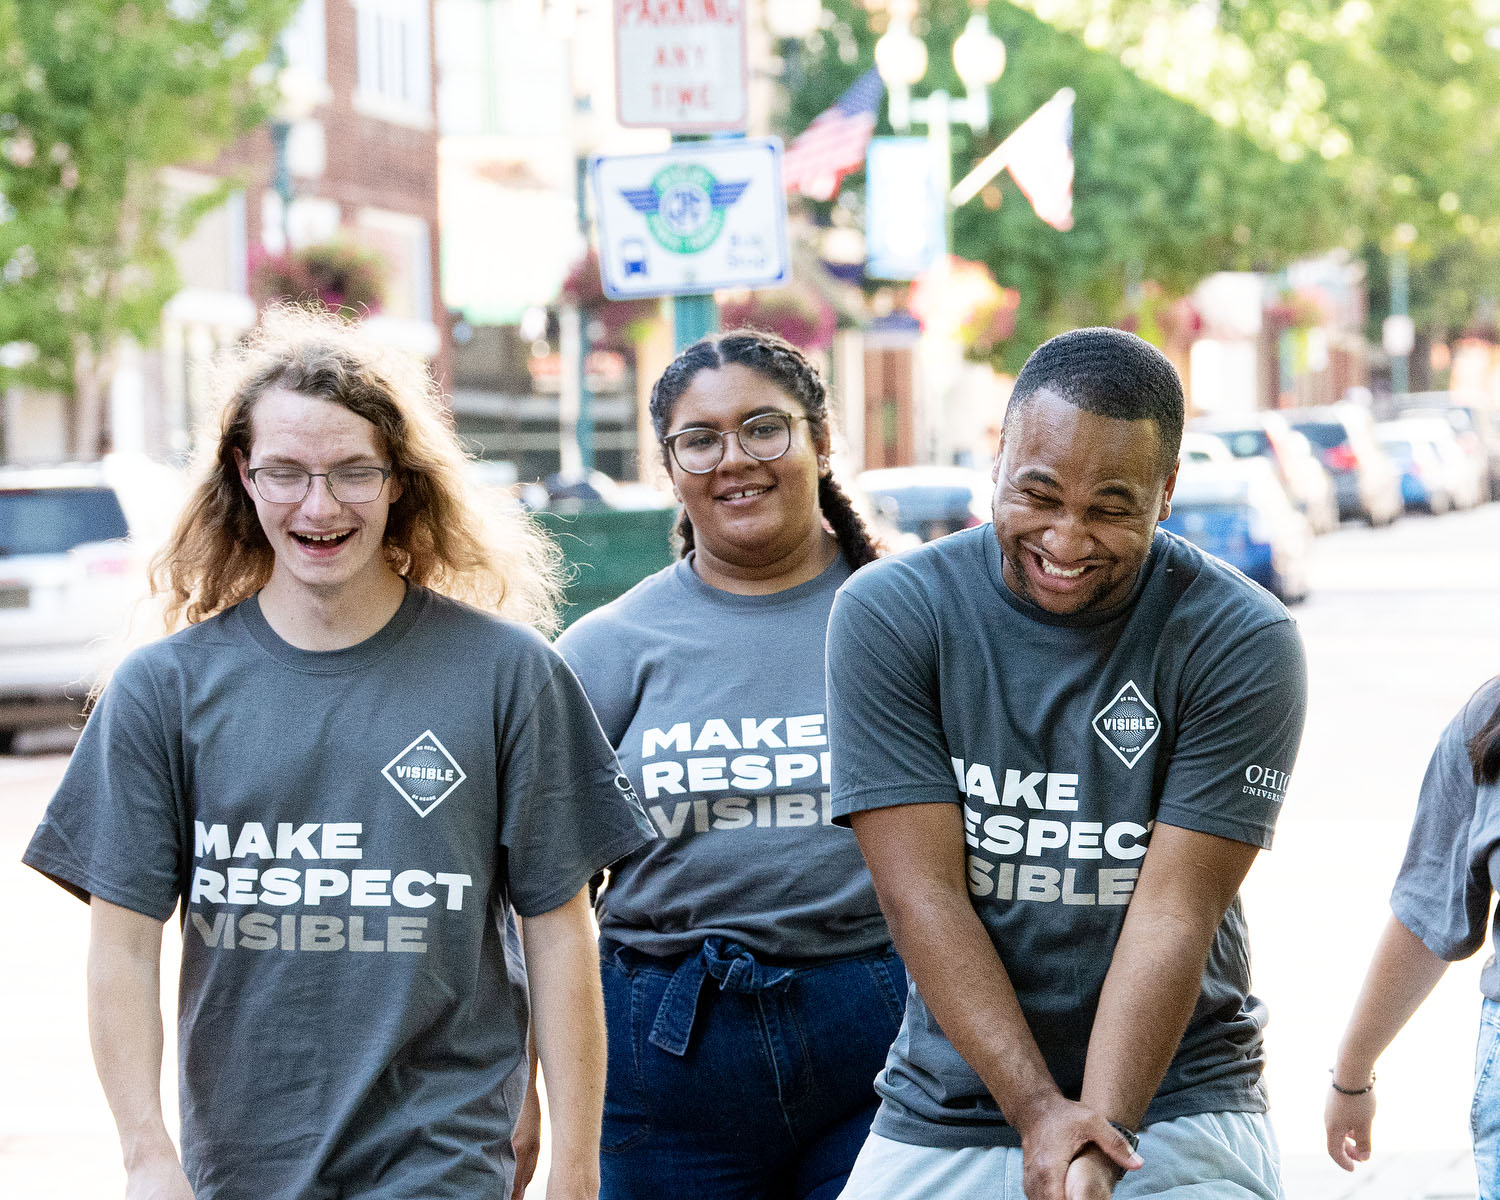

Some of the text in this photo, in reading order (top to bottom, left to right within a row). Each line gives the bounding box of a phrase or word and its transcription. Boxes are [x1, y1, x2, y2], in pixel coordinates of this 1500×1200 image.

[654, 45, 707, 68] ANY
[651, 82, 712, 110] TIME
[642, 713, 827, 758] MAKE
[1103, 717, 1155, 731] VISIBLE
[396, 765, 454, 782] VISIBLE
[642, 752, 830, 799] RESP
[1242, 785, 1285, 803] UNIVERS
[650, 792, 831, 839] VISIB
[964, 802, 1154, 860] ESPEC
[194, 820, 363, 860] MAKE
[191, 866, 473, 911] RESPECT
[967, 855, 1139, 906] SIBLE
[190, 912, 428, 953] VISIBLE
